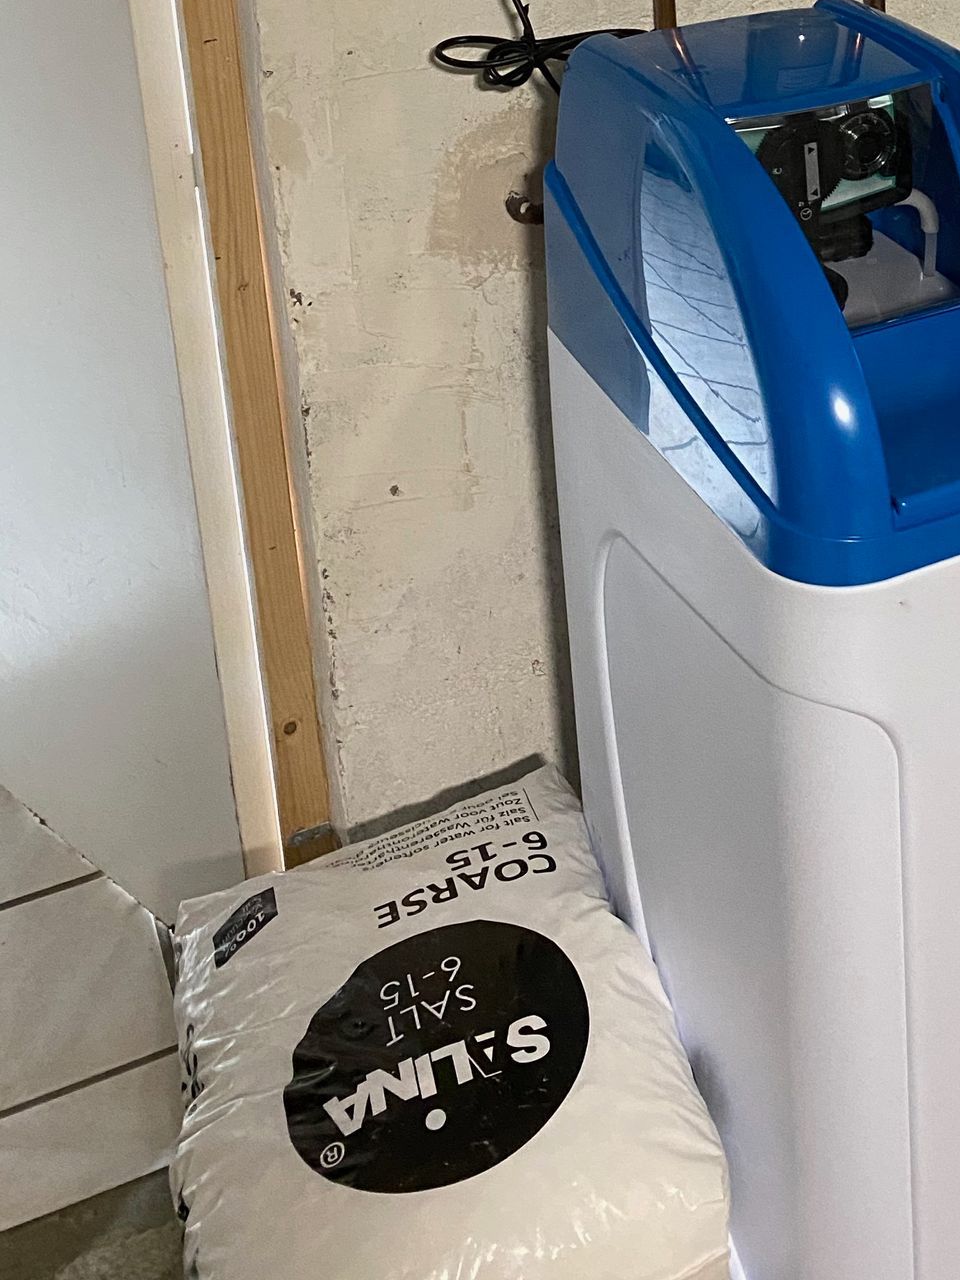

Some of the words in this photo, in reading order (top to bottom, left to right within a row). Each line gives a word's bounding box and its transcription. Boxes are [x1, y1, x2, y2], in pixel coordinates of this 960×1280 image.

[454, 809, 487, 819] voor
[490, 798, 523, 811] Zout
[498, 807, 526, 817] Salz
[475, 815, 495, 824] für
[480, 823, 501, 832] for
[504, 816, 531, 826] Salt
[434, 830, 476, 847] water
[362, 845, 430, 871] softeners
[446, 831, 548, 870] 6-15
[374, 854, 557, 928] COARSE
[225, 911, 265, 957] 100%
[380, 956, 461, 1010] 6-15
[386, 984, 477, 1047] SALT
[323, 1014, 550, 1136] SALINA
